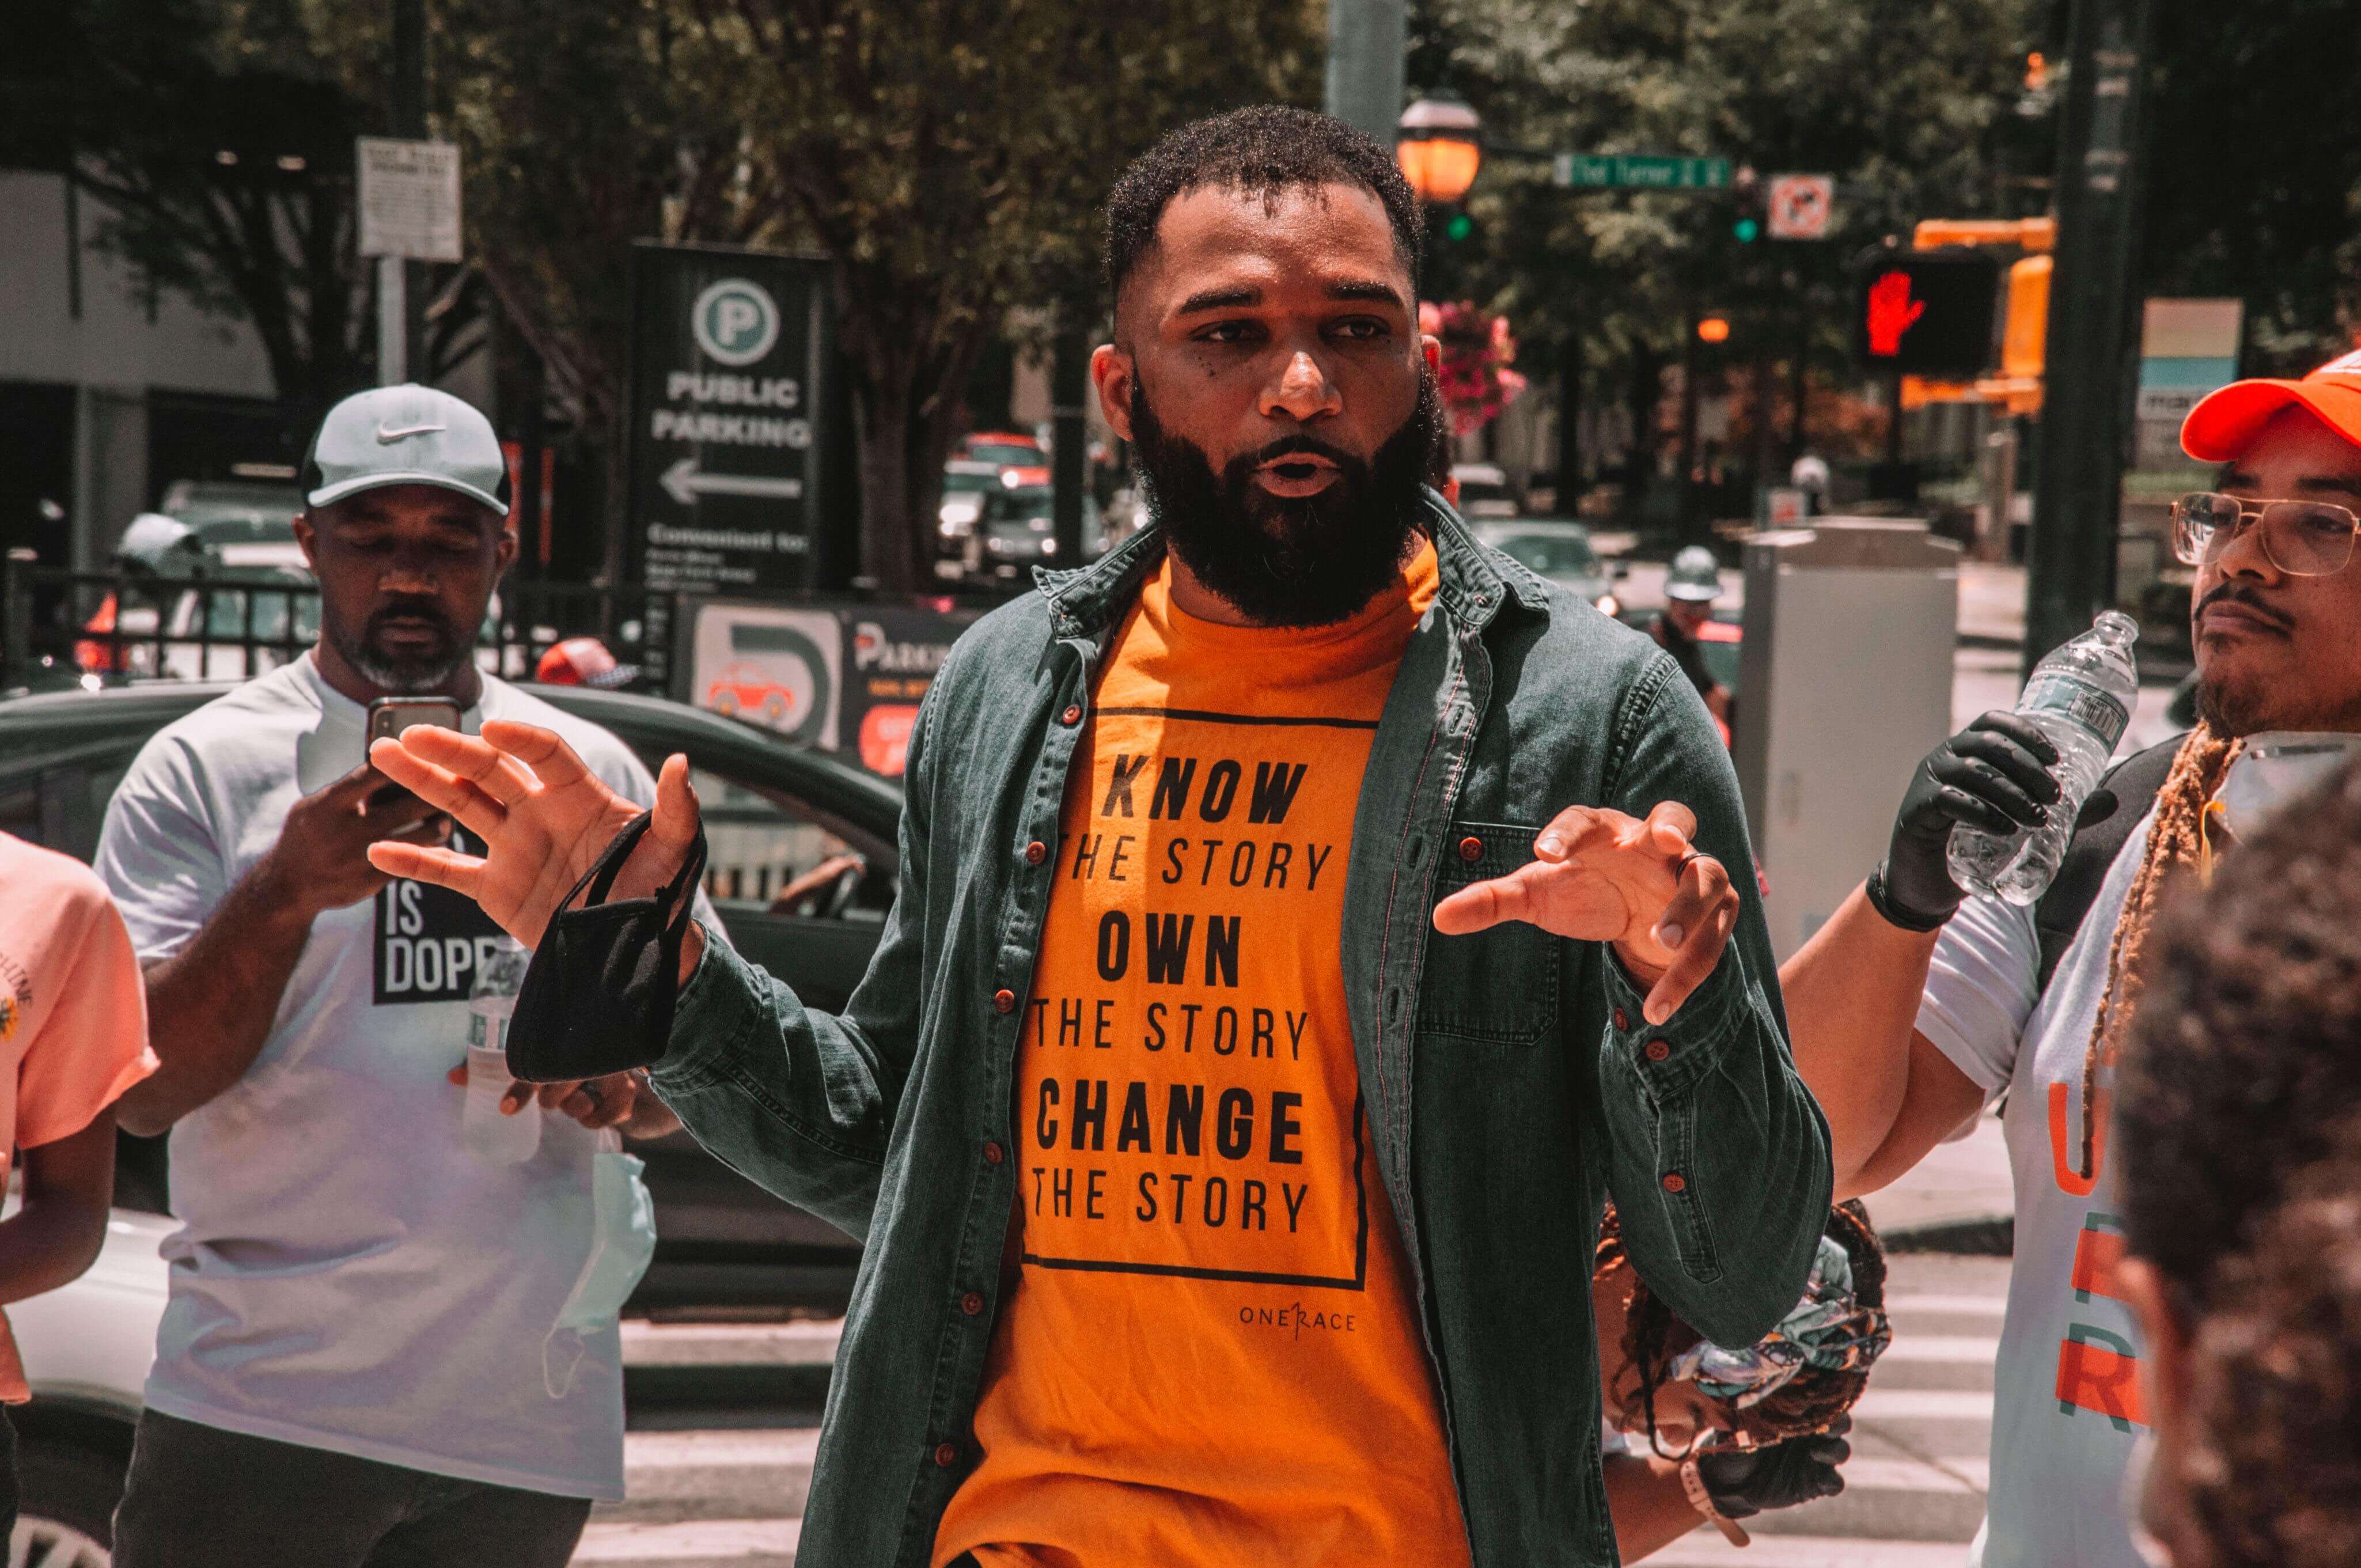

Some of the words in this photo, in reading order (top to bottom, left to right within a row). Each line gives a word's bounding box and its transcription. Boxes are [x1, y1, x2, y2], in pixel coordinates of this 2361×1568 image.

[718, 300, 757, 344] P
[668, 372, 798, 408] PUBLIC
[652, 410, 812, 449] PARKING
[1101, 753, 1308, 824] KNOW
[1059, 833, 1135, 881] HE
[1162, 838, 1332, 891] STORY
[385, 880, 424, 936] IS
[1097, 910, 1241, 988] OWN
[1032, 998, 1115, 1048] THE
[1145, 1002, 1308, 1061] STORY
[1037, 1077, 1303, 1165] CHANGE
[1032, 1167, 1106, 1219] THE
[1136, 1171, 1308, 1233] STORY
